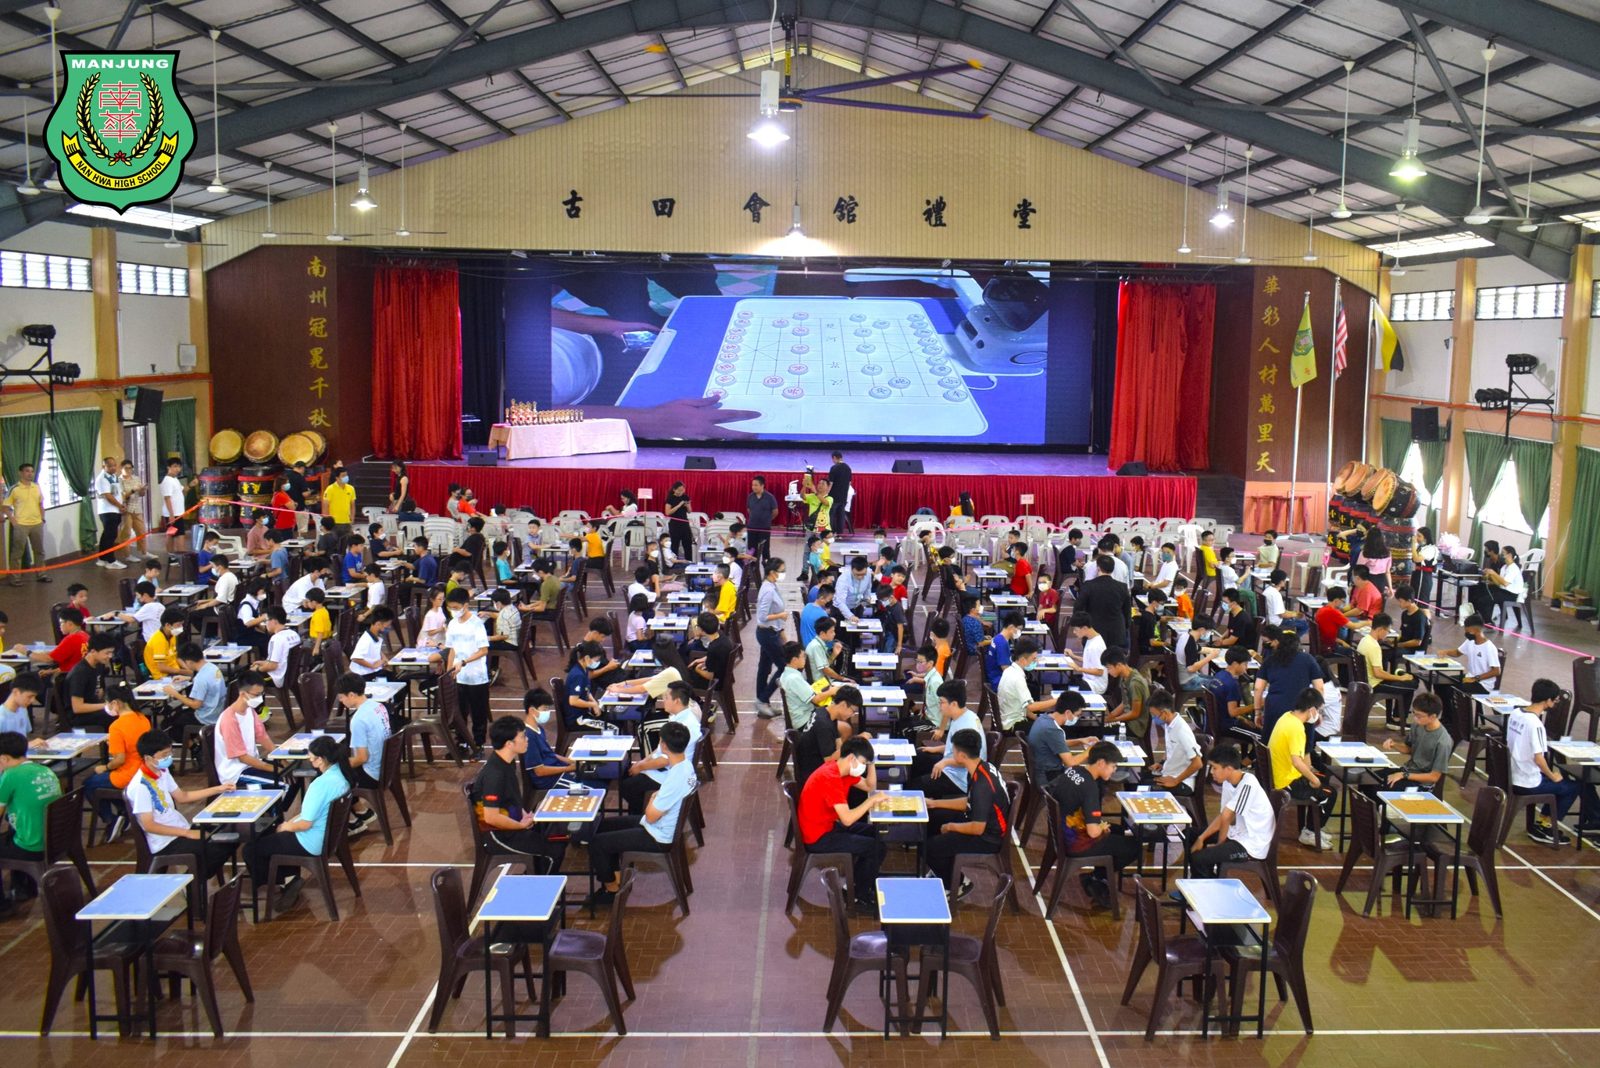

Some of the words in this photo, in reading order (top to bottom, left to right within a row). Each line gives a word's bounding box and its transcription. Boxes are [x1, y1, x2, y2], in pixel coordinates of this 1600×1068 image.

[562, 189, 1037, 229] 古田會館禮堂
